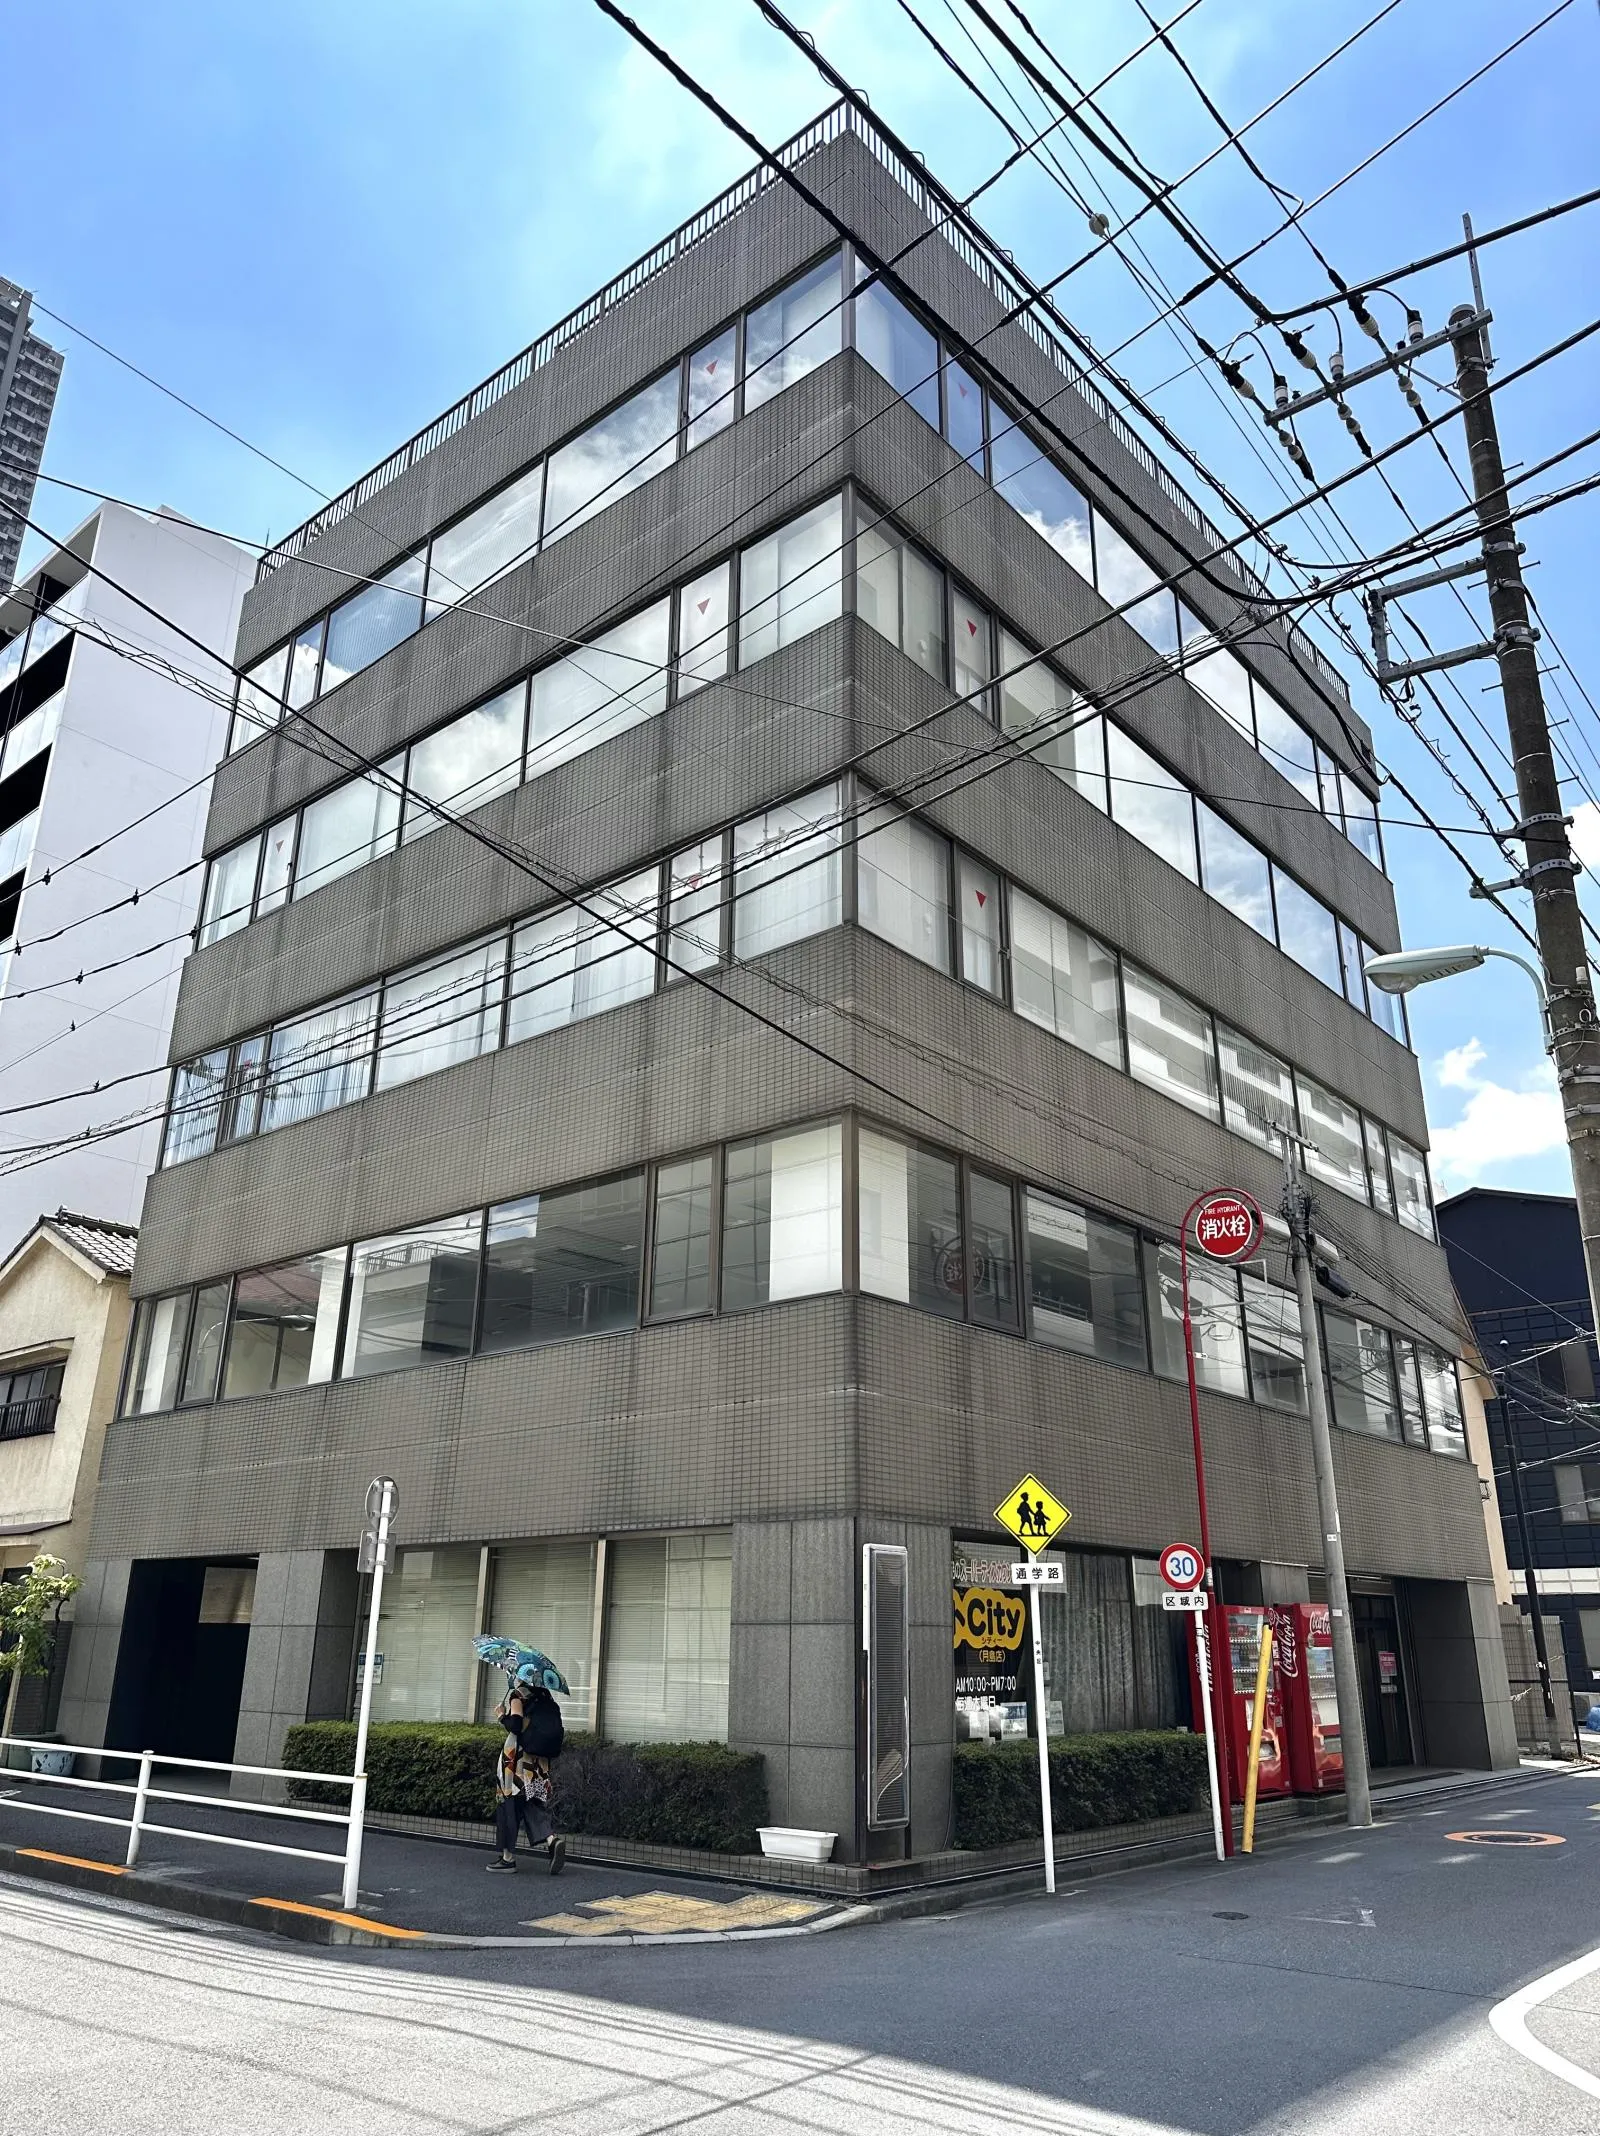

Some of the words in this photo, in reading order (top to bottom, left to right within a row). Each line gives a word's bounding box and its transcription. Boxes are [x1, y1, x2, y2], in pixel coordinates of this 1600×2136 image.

[1205, 1207, 1216, 1215] FIRE
[1217, 1205, 1240, 1214] HYDRANT
[1201, 1214, 1247, 1240] 消火栓
[1016, 1567, 1059, 1580] 通学路
[1170, 1556, 1194, 1577] 30
[1165, 1595, 1204, 1607] 区域内
[1309, 1611, 1332, 1635] Coca-Co
